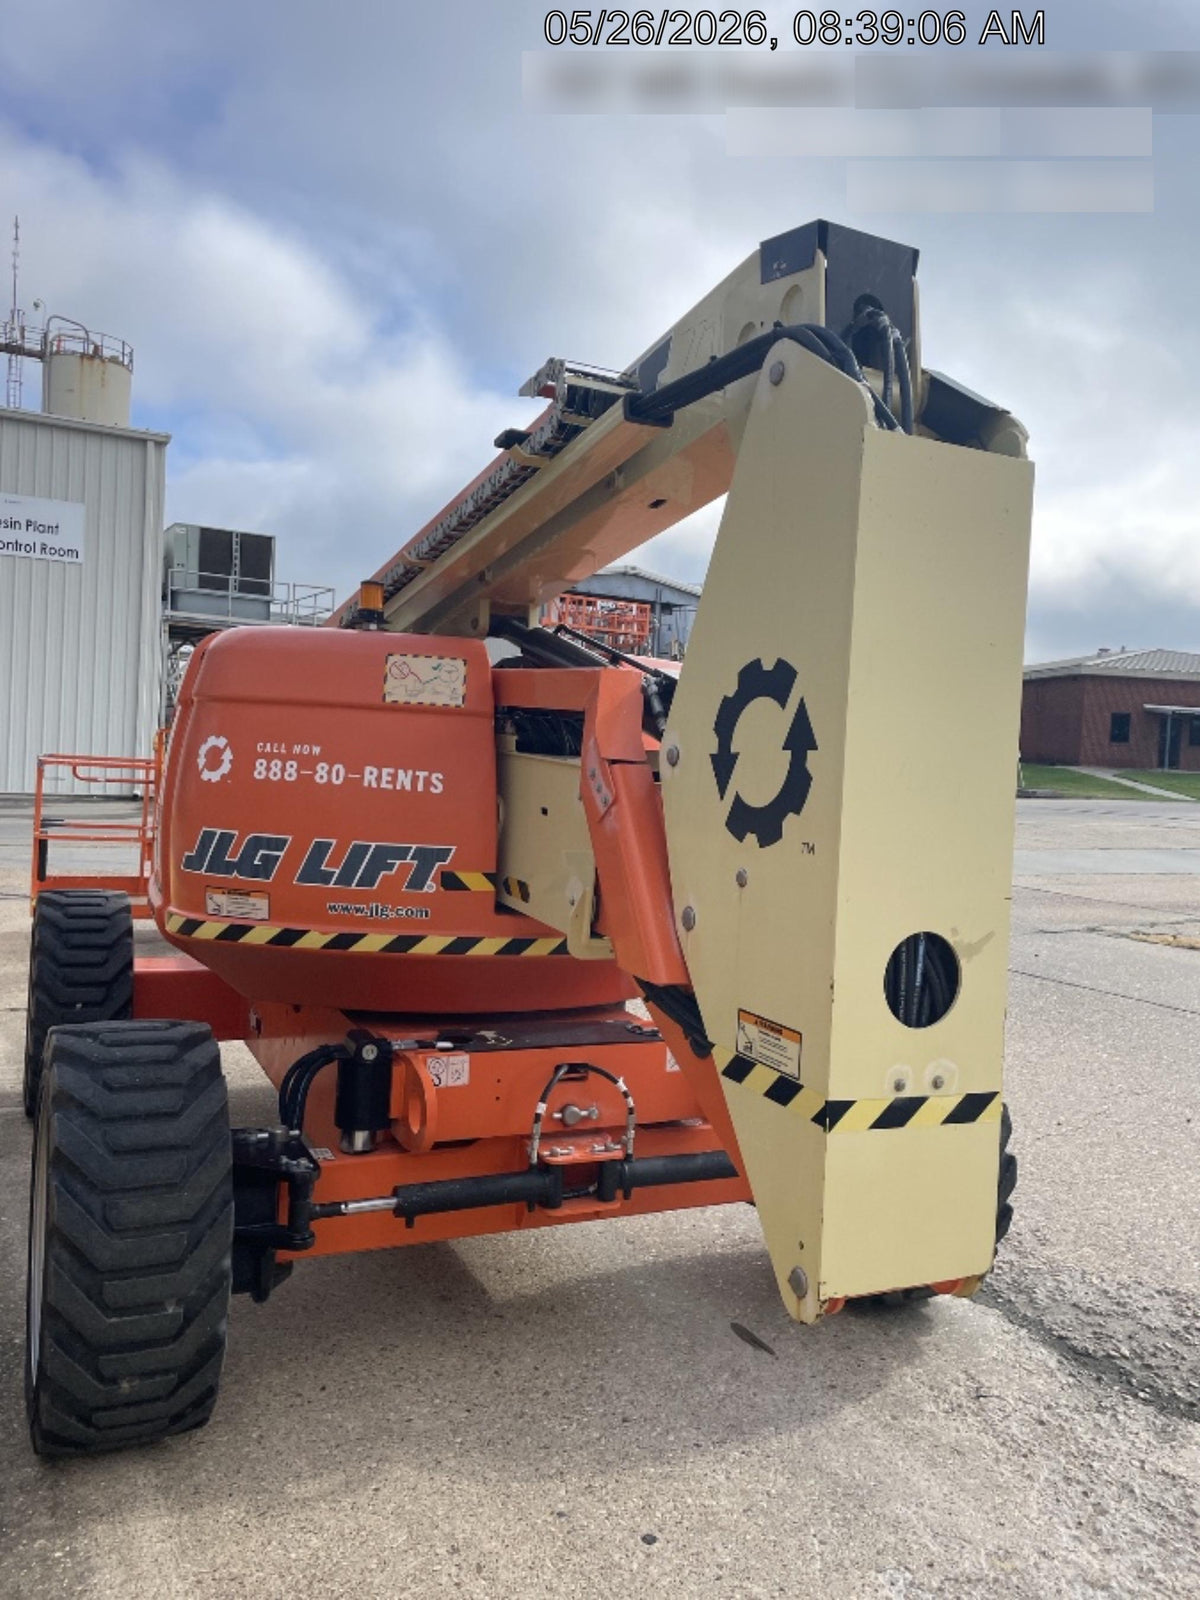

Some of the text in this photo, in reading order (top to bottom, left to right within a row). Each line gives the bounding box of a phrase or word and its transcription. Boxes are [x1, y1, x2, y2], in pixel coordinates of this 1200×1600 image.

[0, 516, 60, 536] sin Plant
[40, 542, 79, 559] Room
[256, 742, 321, 756] CALL NOW
[253, 758, 444, 794] 888-80-RENTS
[181, 826, 293, 882] JLG
[327, 902, 431, 920] www.jlg.com
